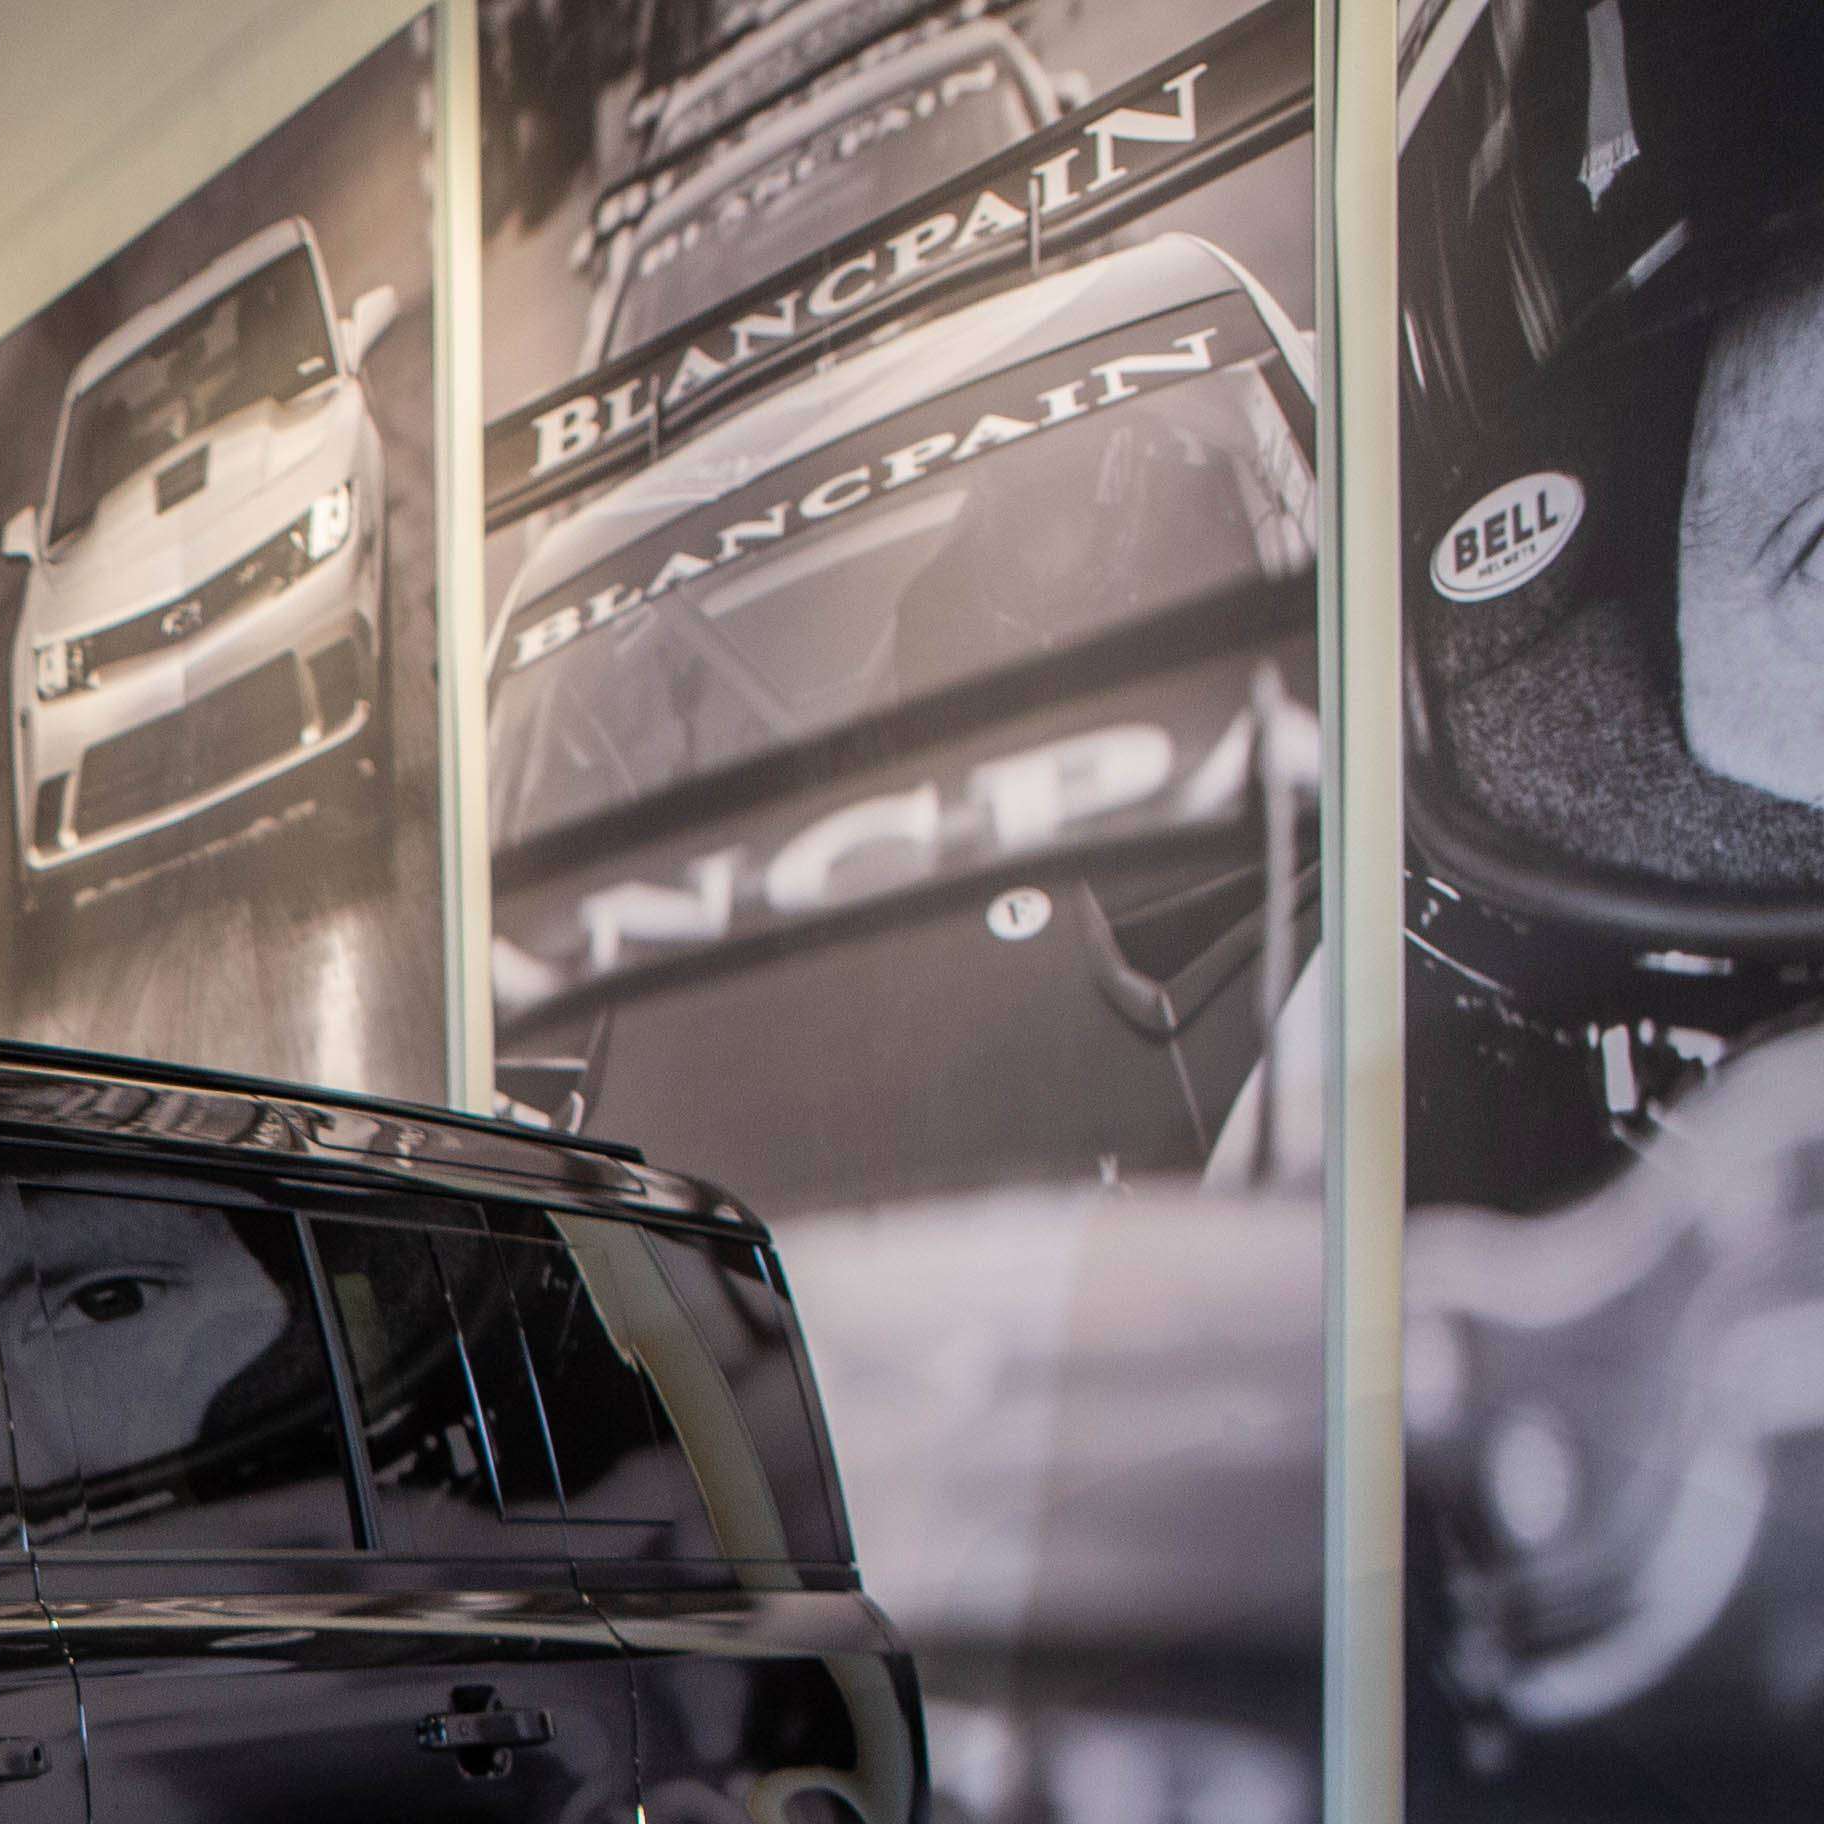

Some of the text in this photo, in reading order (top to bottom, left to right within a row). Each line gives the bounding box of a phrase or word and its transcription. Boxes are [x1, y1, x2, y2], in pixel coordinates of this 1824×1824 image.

[528, 63, 1209, 478] BLANCPAIN
[511, 327, 1218, 670] BLANCPAIN
[1454, 489, 1558, 575] BELL
